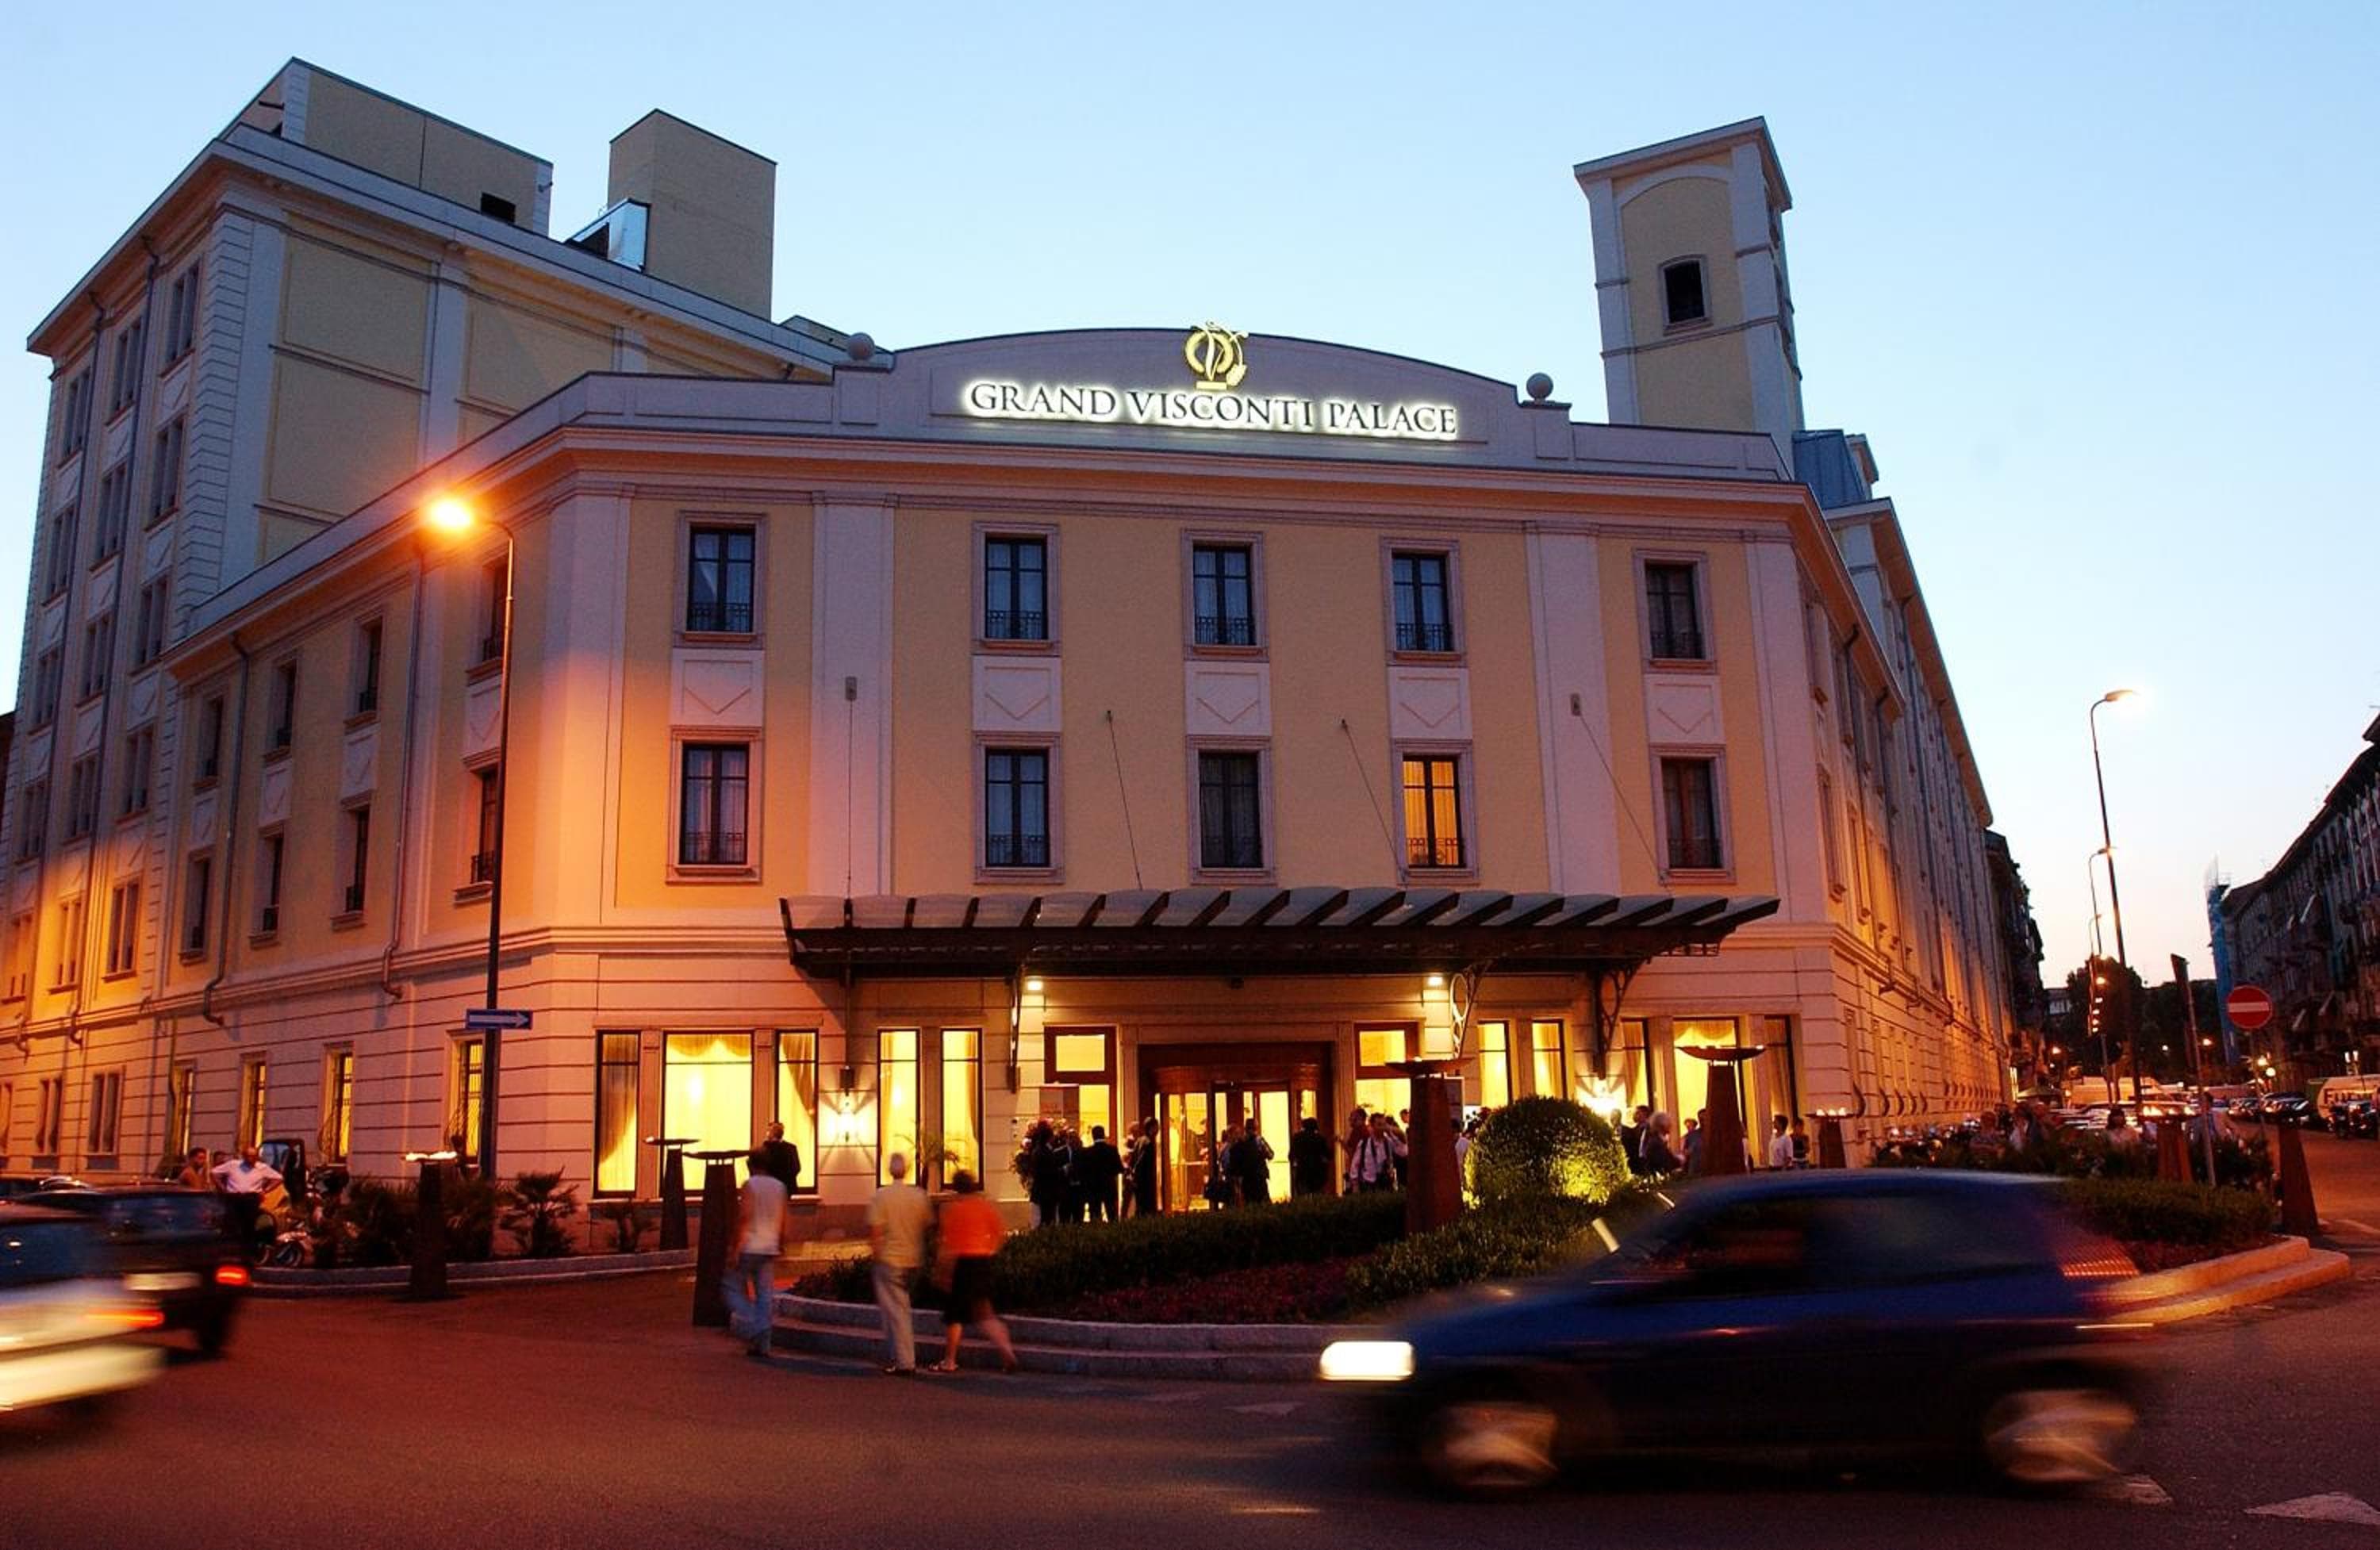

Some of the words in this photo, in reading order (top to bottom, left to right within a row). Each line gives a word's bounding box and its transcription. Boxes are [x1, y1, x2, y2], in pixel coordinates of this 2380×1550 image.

[970, 383, 1116, 415] GRAND
[1127, 391, 1314, 427] VISCONTI
[1326, 402, 1457, 434] PALACE
